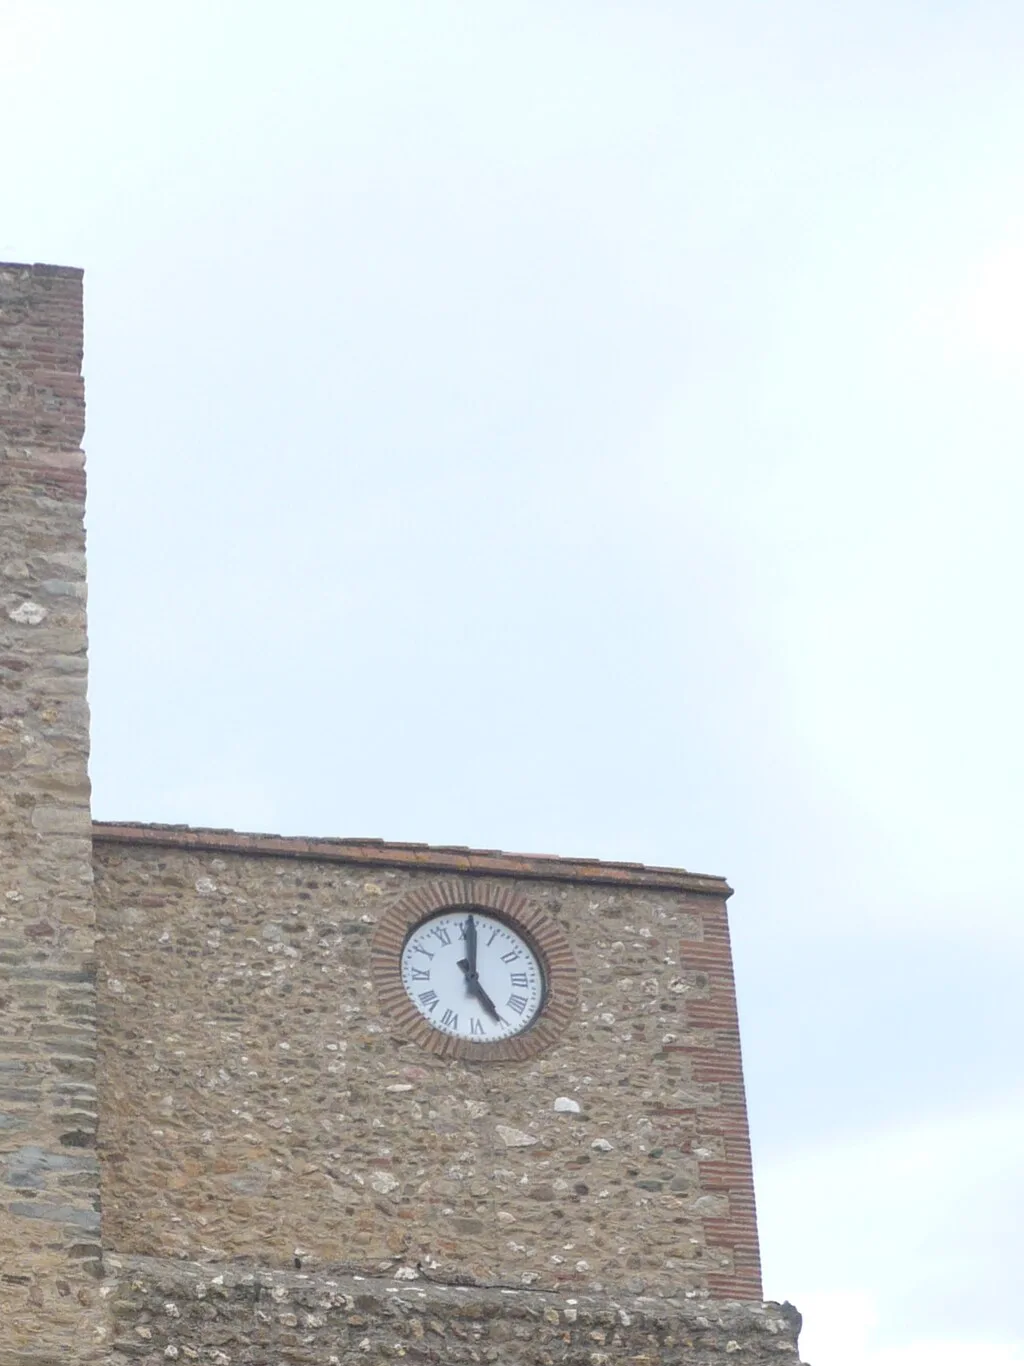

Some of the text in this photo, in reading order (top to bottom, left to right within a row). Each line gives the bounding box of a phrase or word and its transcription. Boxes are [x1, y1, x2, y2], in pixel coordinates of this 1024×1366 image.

[432, 928, 452, 948] XI
[414, 943, 434, 961] X
[500, 950, 520, 964] II
[411, 967, 430, 981] IX
[511, 972, 528, 988] III
[418, 989, 440, 1013] VIII
[441, 1008, 459, 1030] VII
[470, 1017, 486, 1035] VI
